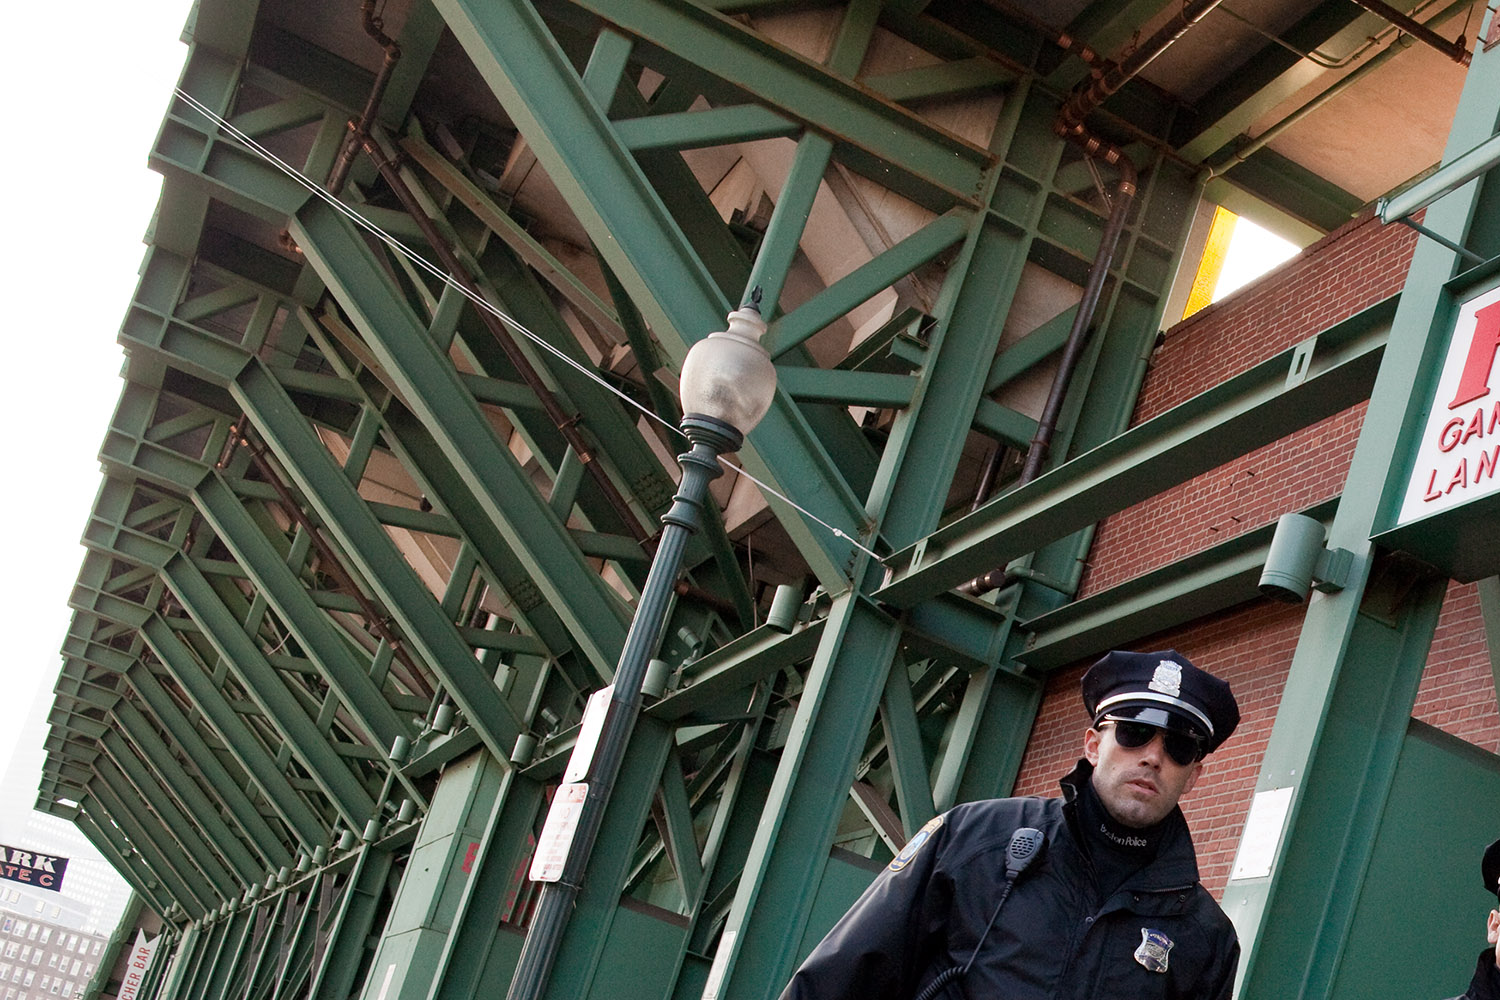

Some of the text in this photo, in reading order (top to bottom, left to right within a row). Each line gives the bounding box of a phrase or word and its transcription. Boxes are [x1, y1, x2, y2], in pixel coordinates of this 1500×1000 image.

[1125, 836, 1147, 846] Police
[39, 873, 54, 887] C
[133, 946, 151, 969] BAR
